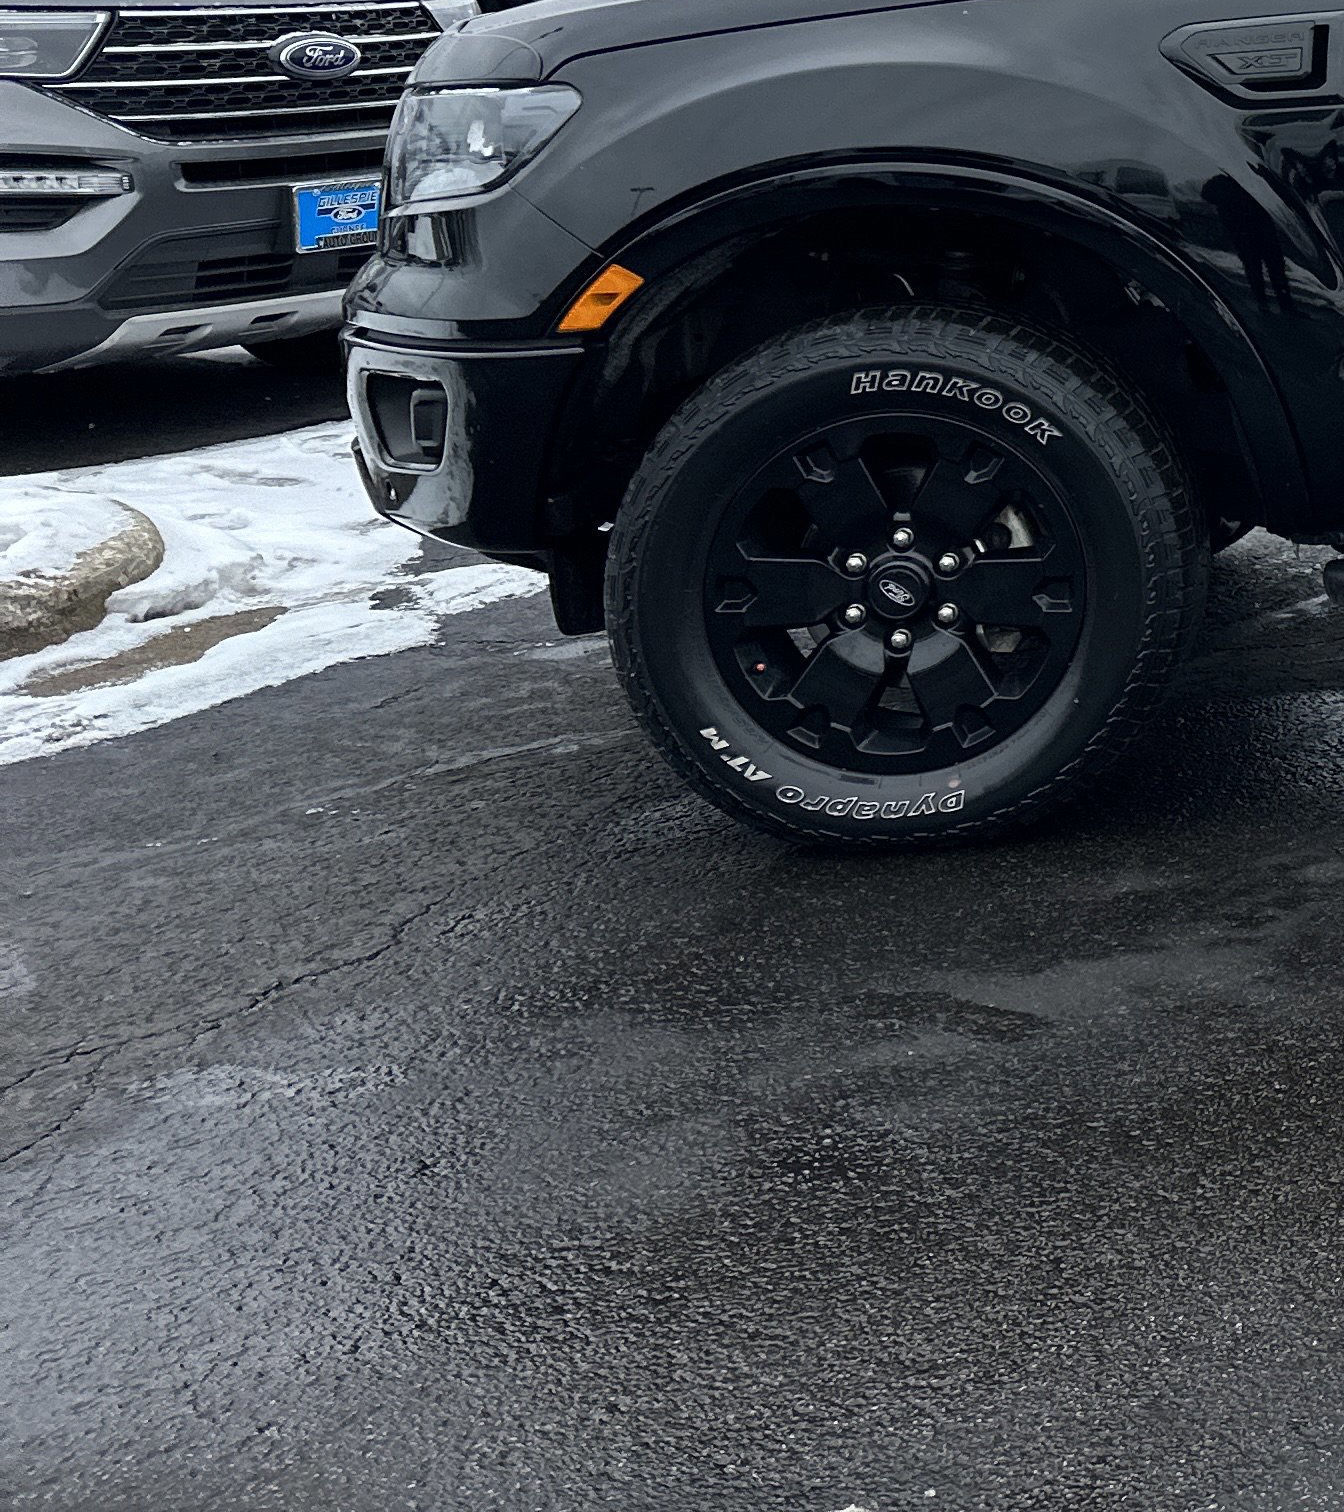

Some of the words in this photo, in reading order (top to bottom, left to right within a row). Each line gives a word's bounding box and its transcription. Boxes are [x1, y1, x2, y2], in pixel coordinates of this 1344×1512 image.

[1194, 32, 1305, 50] RANGER
[303, 45, 345, 67] Ford
[317, 191, 378, 208] GILLESPIE
[350, 230, 378, 245] GROU
[776, 786, 965, 819] Dynapro
